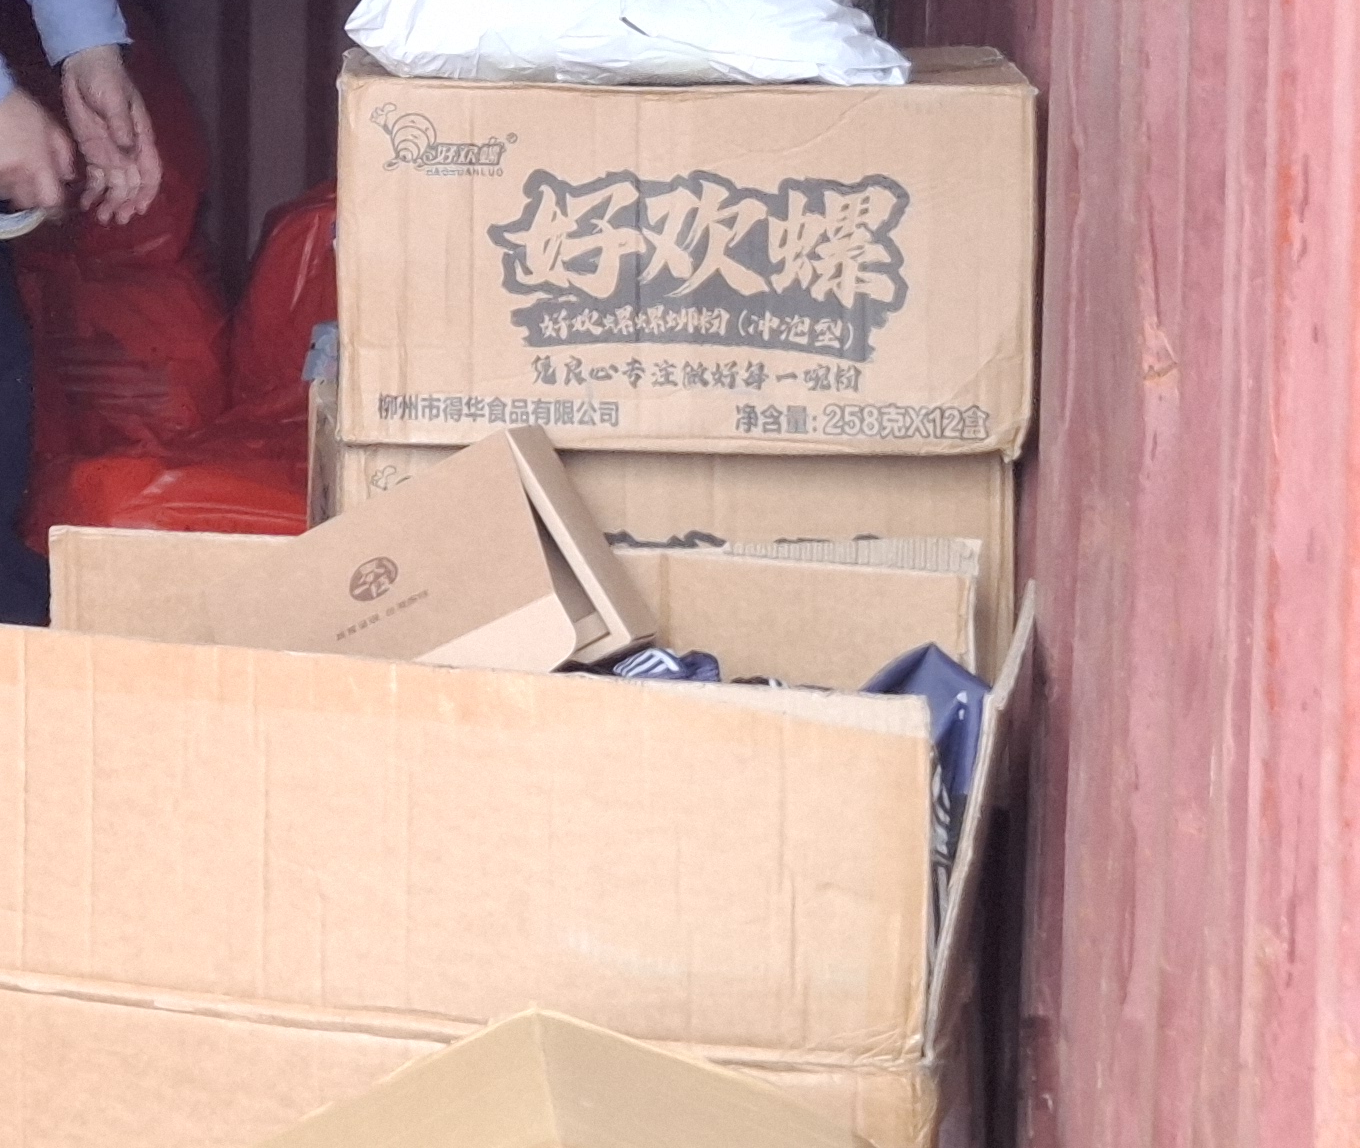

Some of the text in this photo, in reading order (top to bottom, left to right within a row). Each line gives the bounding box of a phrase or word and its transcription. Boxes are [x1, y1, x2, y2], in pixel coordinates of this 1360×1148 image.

[500, 178, 900, 309] 好欢螺
[378, 395, 620, 427] 柳州市得华食品有限公司
